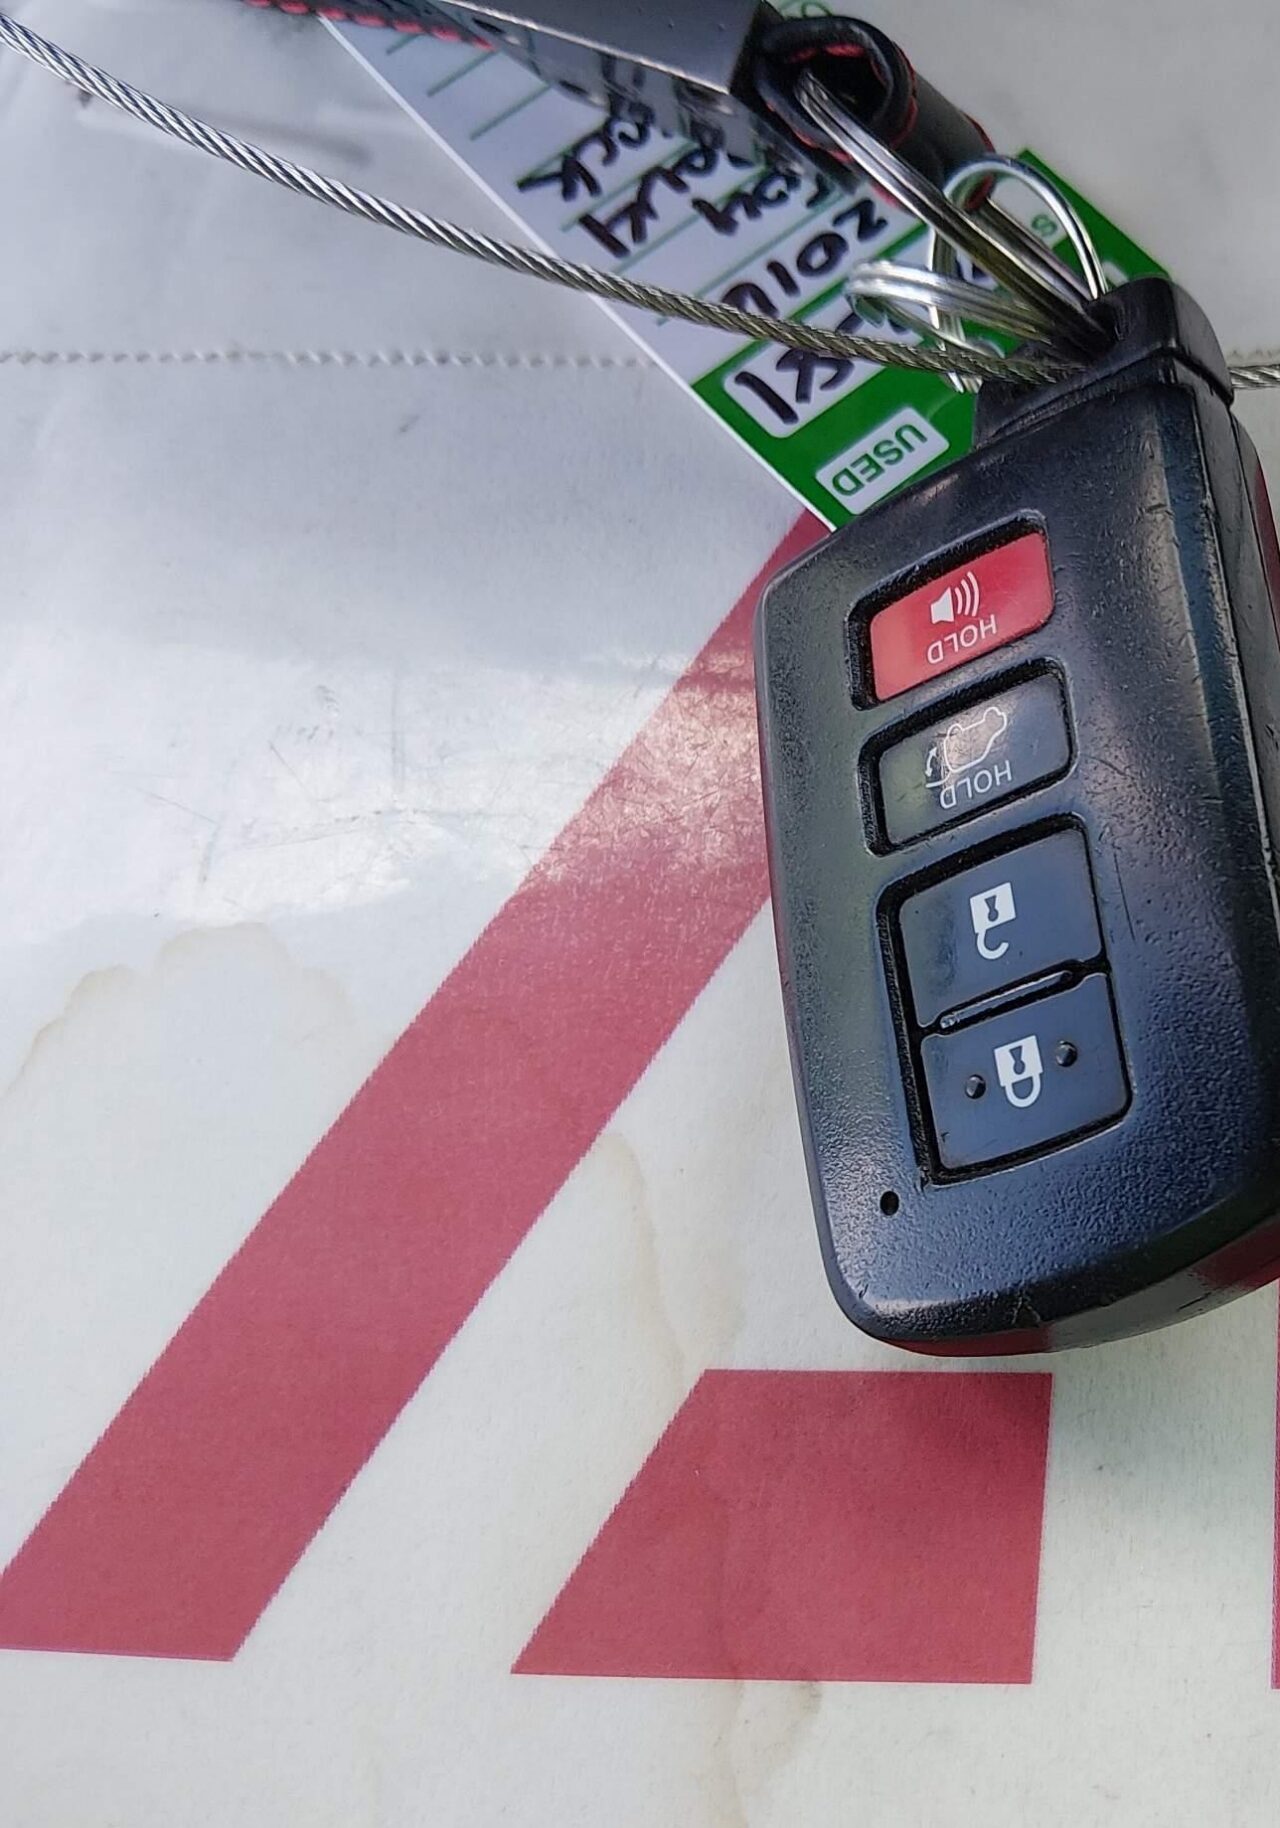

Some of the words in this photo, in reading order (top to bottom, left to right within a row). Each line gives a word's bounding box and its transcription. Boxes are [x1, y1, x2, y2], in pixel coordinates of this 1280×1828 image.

[830, 422, 929, 497] USED
[926, 614, 998, 665] HOLD
[940, 759, 1013, 809] HOLD
